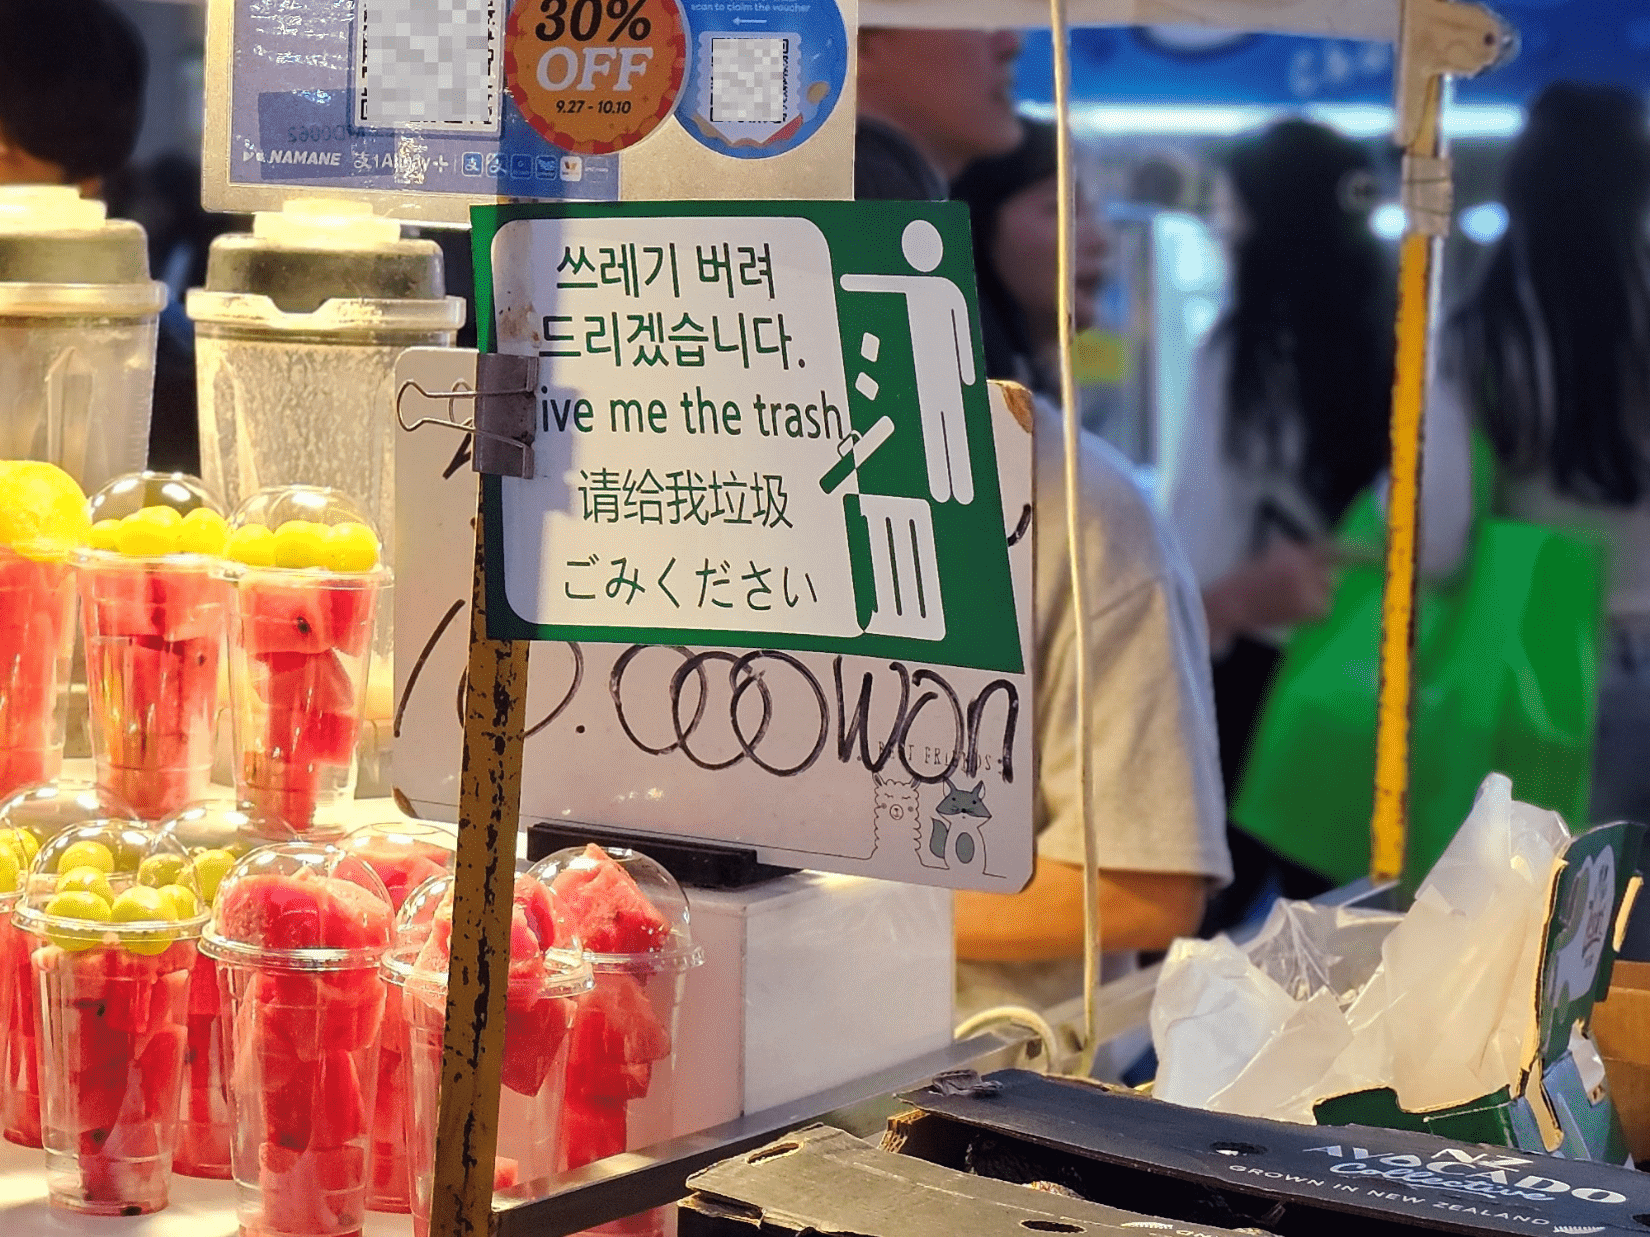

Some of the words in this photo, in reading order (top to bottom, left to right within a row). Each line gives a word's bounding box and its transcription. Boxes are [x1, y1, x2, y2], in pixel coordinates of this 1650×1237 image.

[536, 46, 654, 92] OFF
[556, 99, 586, 113] 9.27
[597, 99, 632, 113] 10.10
[269, 150, 343, 166] NAMANE
[556, 242, 681, 299] 쓰레기
[697, 242, 776, 300] 버려
[538, 311, 807, 371] 드리겠습니다.
[541, 386, 595, 433] ive
[610, 400, 668, 435] me
[680, 385, 742, 437] the
[753, 390, 844, 440] trash
[577, 467, 794, 530] 请给我垃圾
[563, 554, 819, 612] ごみください
[1302, 1144, 1628, 1204] AVOCADO
[1329, 1162, 1556, 1202] Collective
[1430, 1148, 1534, 1173] NZ
[1228, 1165, 1325, 1187] GROWN
[1332, 1183, 1360, 1193] IN
[1366, 1189, 1426, 1204] NEW
[1432, 1202, 1550, 1226] ZEALAND
